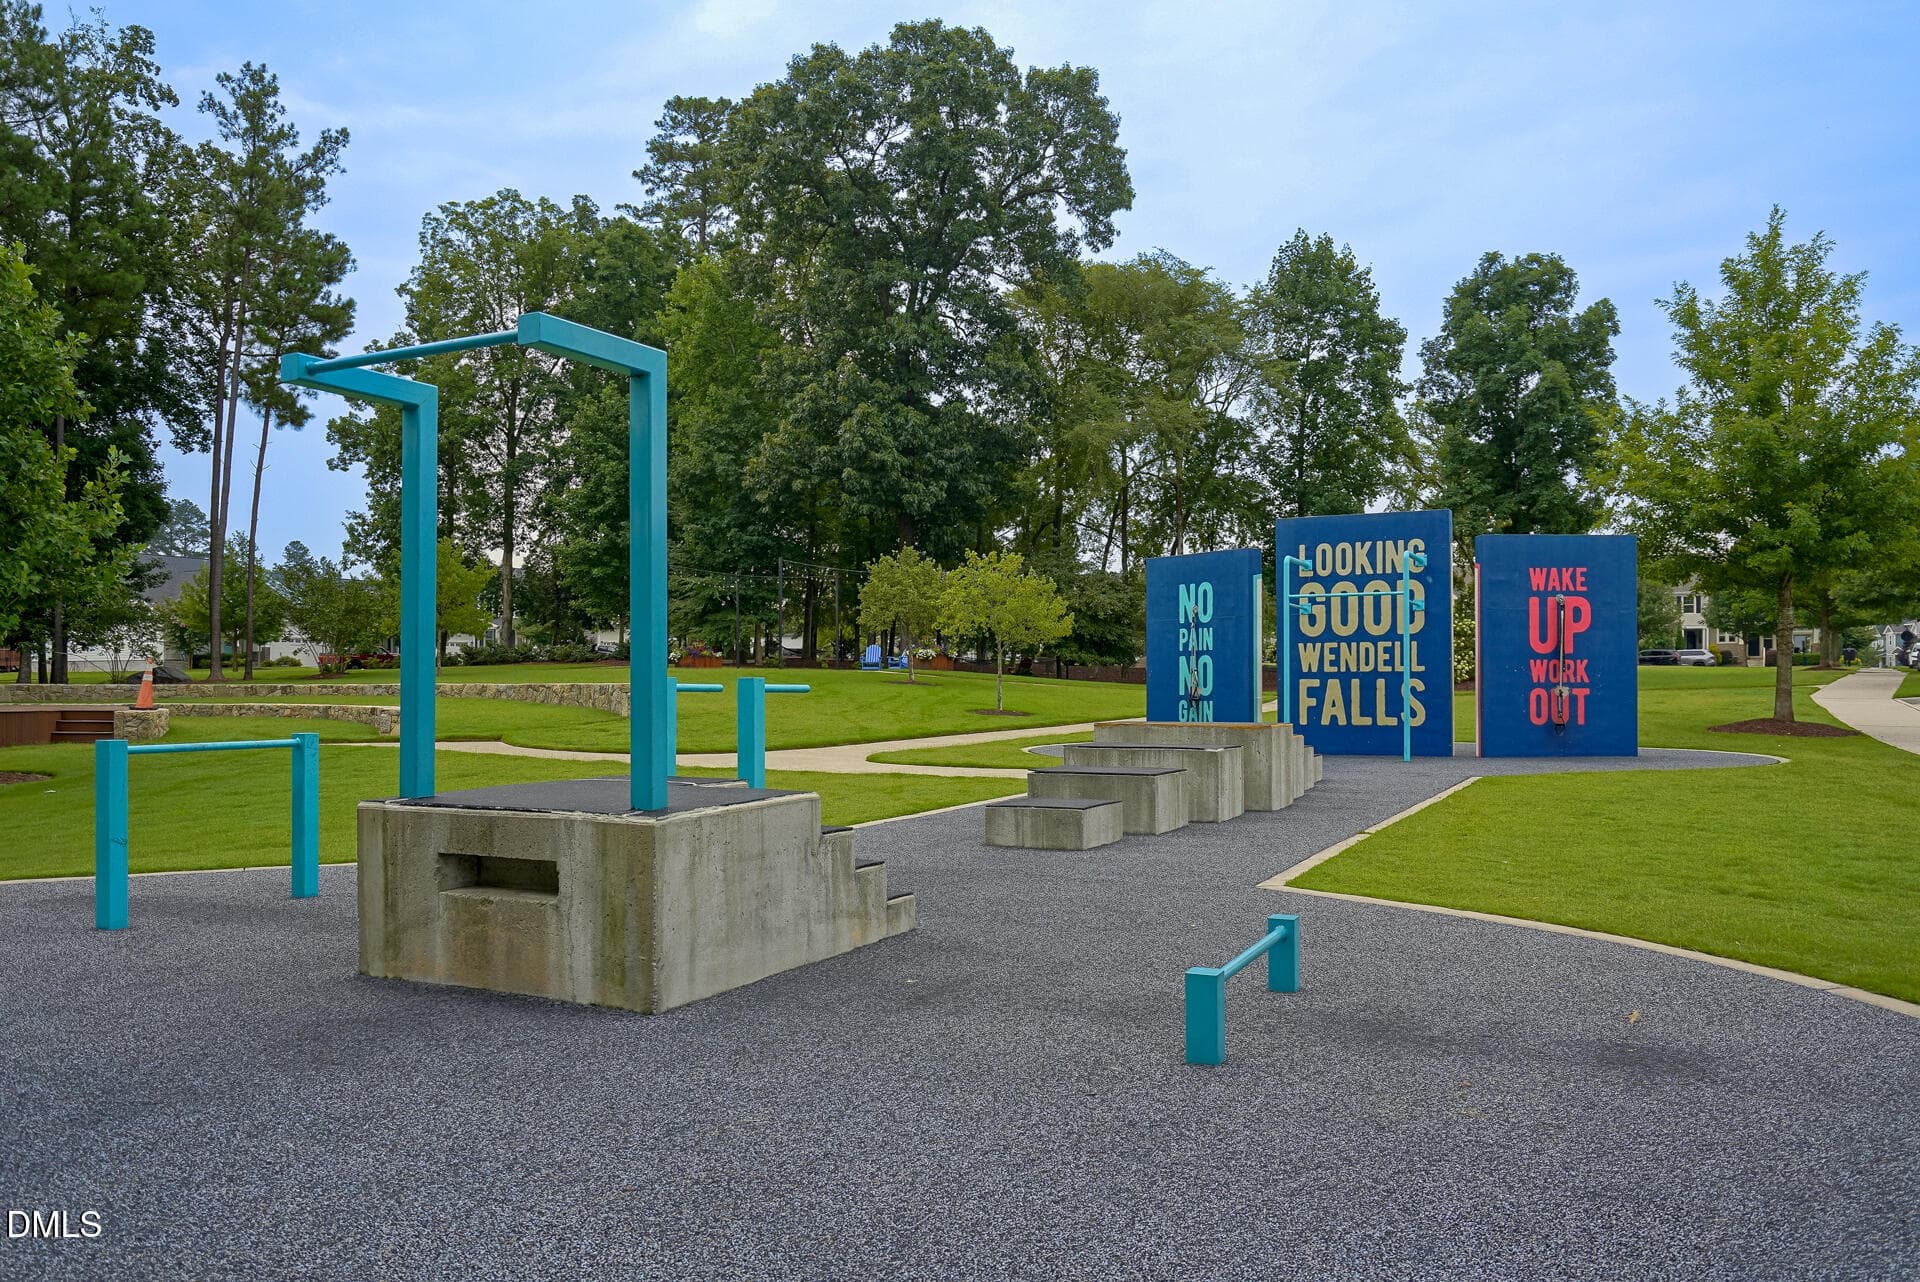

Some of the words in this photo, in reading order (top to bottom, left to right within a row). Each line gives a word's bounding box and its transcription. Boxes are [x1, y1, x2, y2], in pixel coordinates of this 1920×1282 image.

[1298, 538, 1426, 577] LOOKING
[1529, 567, 1588, 592] WAKE
[1178, 581, 1214, 624] NO
[1298, 580, 1426, 637] GOOD
[1178, 627, 1214, 651] PAIN
[1528, 595, 1592, 655] UP
[1178, 655, 1214, 697] NO
[1298, 641, 1426, 673] WENDELL
[1529, 658, 1590, 684] WORK
[1178, 700, 1214, 723] GAIN
[1298, 678, 1426, 727] FALLS
[1529, 687, 1591, 726] OUT
